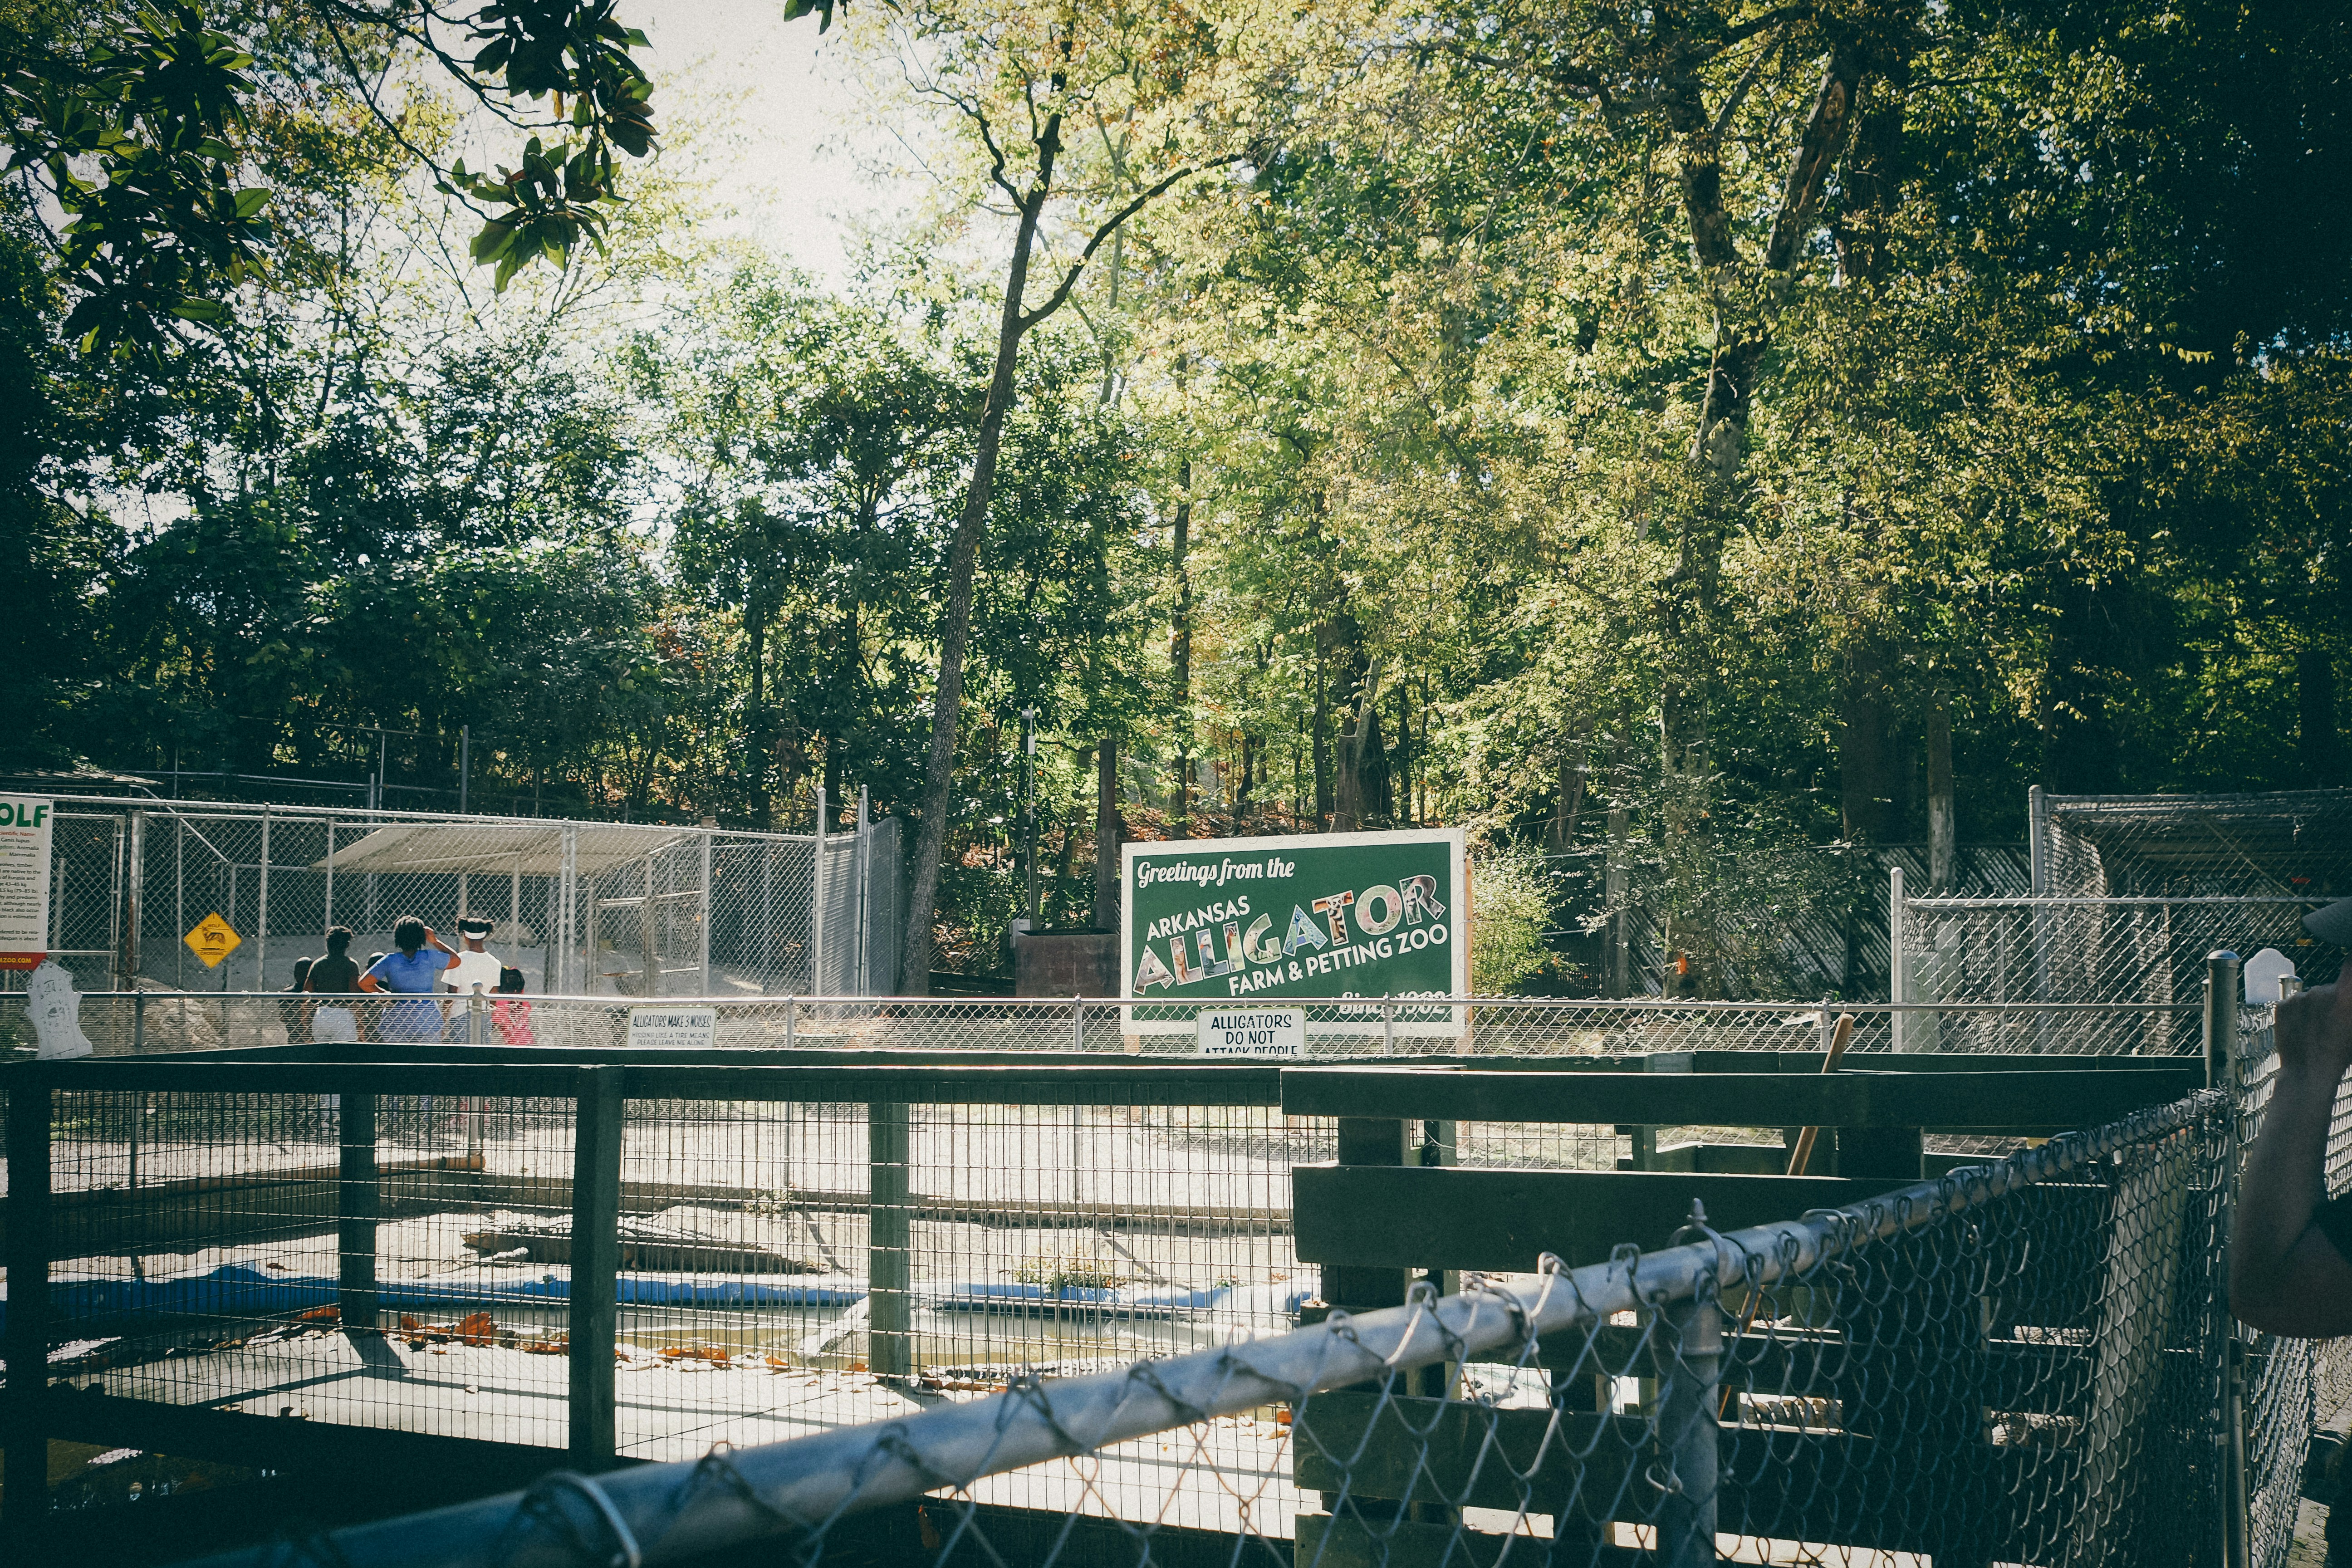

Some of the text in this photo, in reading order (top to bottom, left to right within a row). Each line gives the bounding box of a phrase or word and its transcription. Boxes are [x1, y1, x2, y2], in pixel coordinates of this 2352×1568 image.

[1137, 857, 1295, 888] Greetings from the
[1147, 895, 1250, 941] ARKANSAS
[1132, 874, 1446, 995] ALLIGATOR
[1228, 923, 1448, 997] FARM & PETTING ZOO
[632, 1015, 711, 1028] ALLIGATORS MAKE 3 NOISES
[1211, 1014, 1292, 1029] ALLIGATORS
[1226, 1030, 1275, 1044] DO NOT
